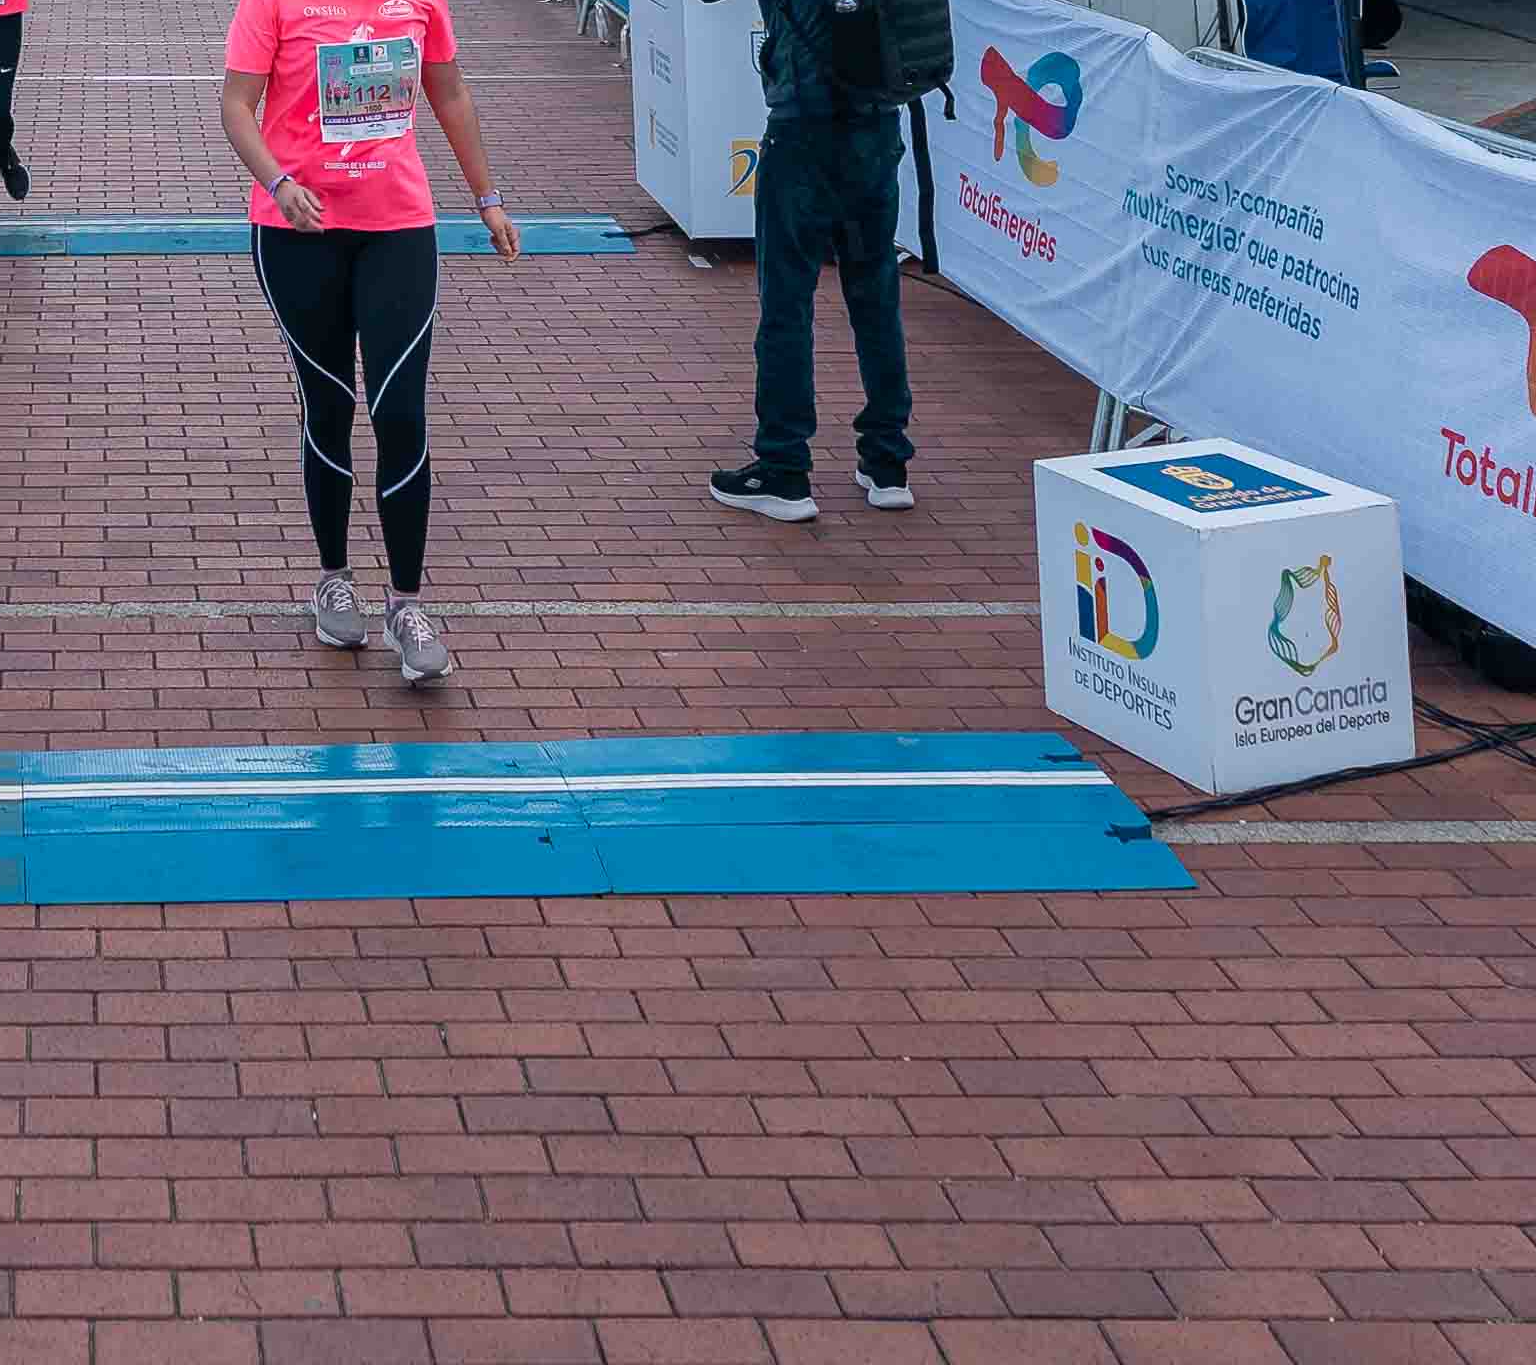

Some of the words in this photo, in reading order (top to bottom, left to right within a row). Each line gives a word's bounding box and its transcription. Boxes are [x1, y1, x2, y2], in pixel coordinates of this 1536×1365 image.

[353, 84, 391, 103] 112
[958, 172, 1057, 263] TotalEnergies
[1141, 240, 1170, 272] tus
[1233, 280, 1322, 341] preferidas
[1247, 241, 1279, 273] que
[1282, 253, 1360, 311] patrocina
[1068, 636, 1125, 683] INSTITUTO
[1128, 665, 1177, 708] INSULAR
[1074, 669, 1090, 690] DE
[1092, 673, 1172, 730] DEPORTES
[1235, 694, 1293, 725] Gran
[1294, 677, 1388, 715] Canaria
[1234, 730, 1257, 748] Isla
[1260, 722, 1312, 746] Europea
[1315, 716, 1336, 733] del
[1339, 709, 1390, 734] Deporte
